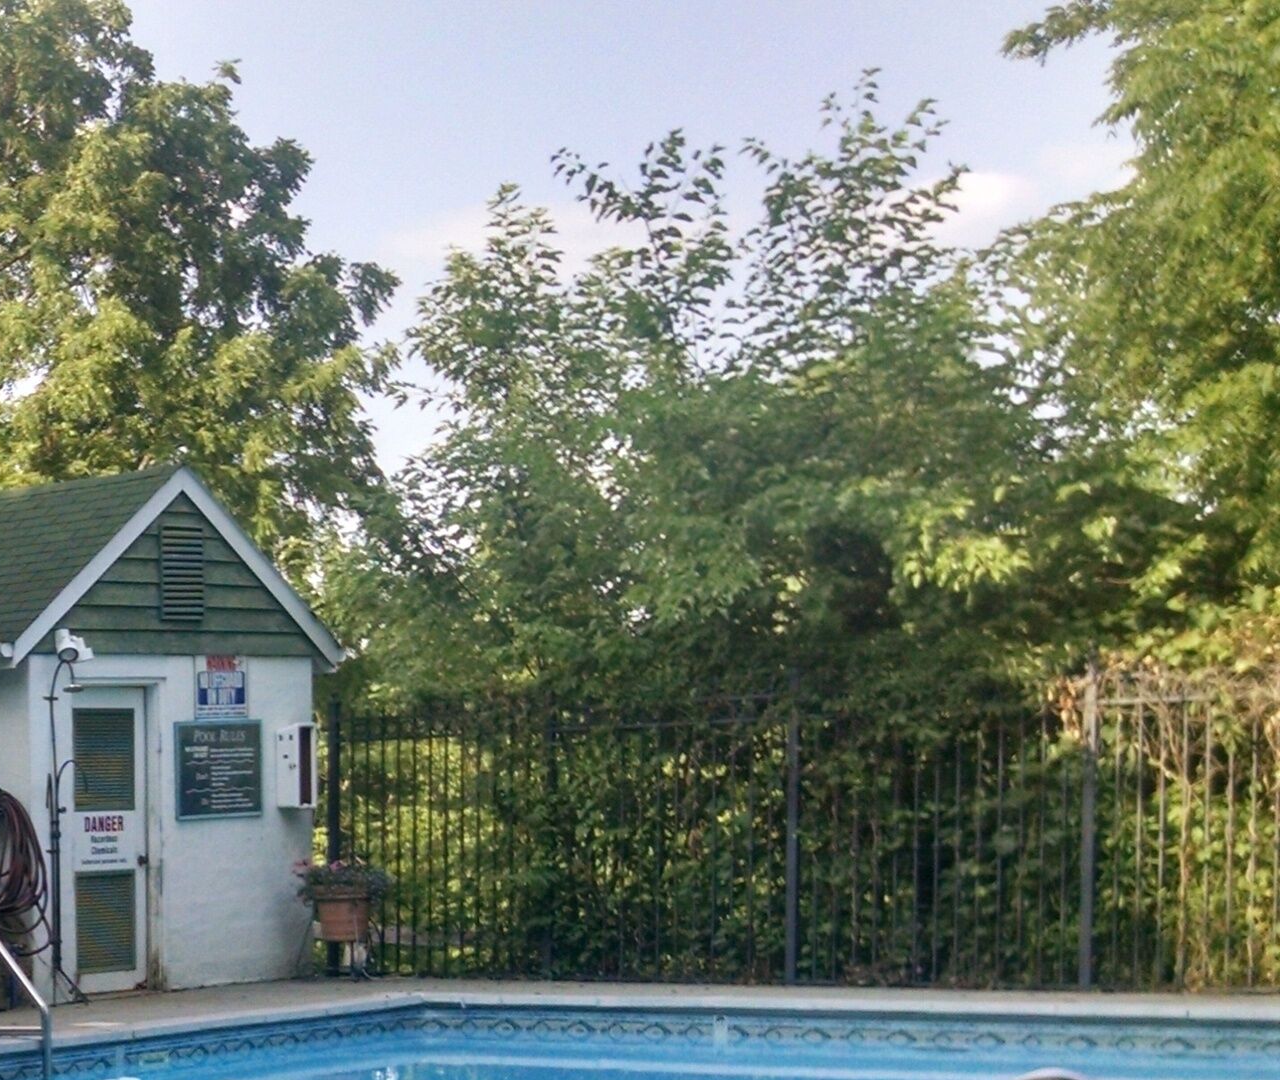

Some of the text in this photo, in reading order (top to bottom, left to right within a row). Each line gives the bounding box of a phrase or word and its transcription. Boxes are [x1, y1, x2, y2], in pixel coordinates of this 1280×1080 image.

[193, 728, 246, 743] POOL RULES
[84, 815, 124, 832] DANGER
